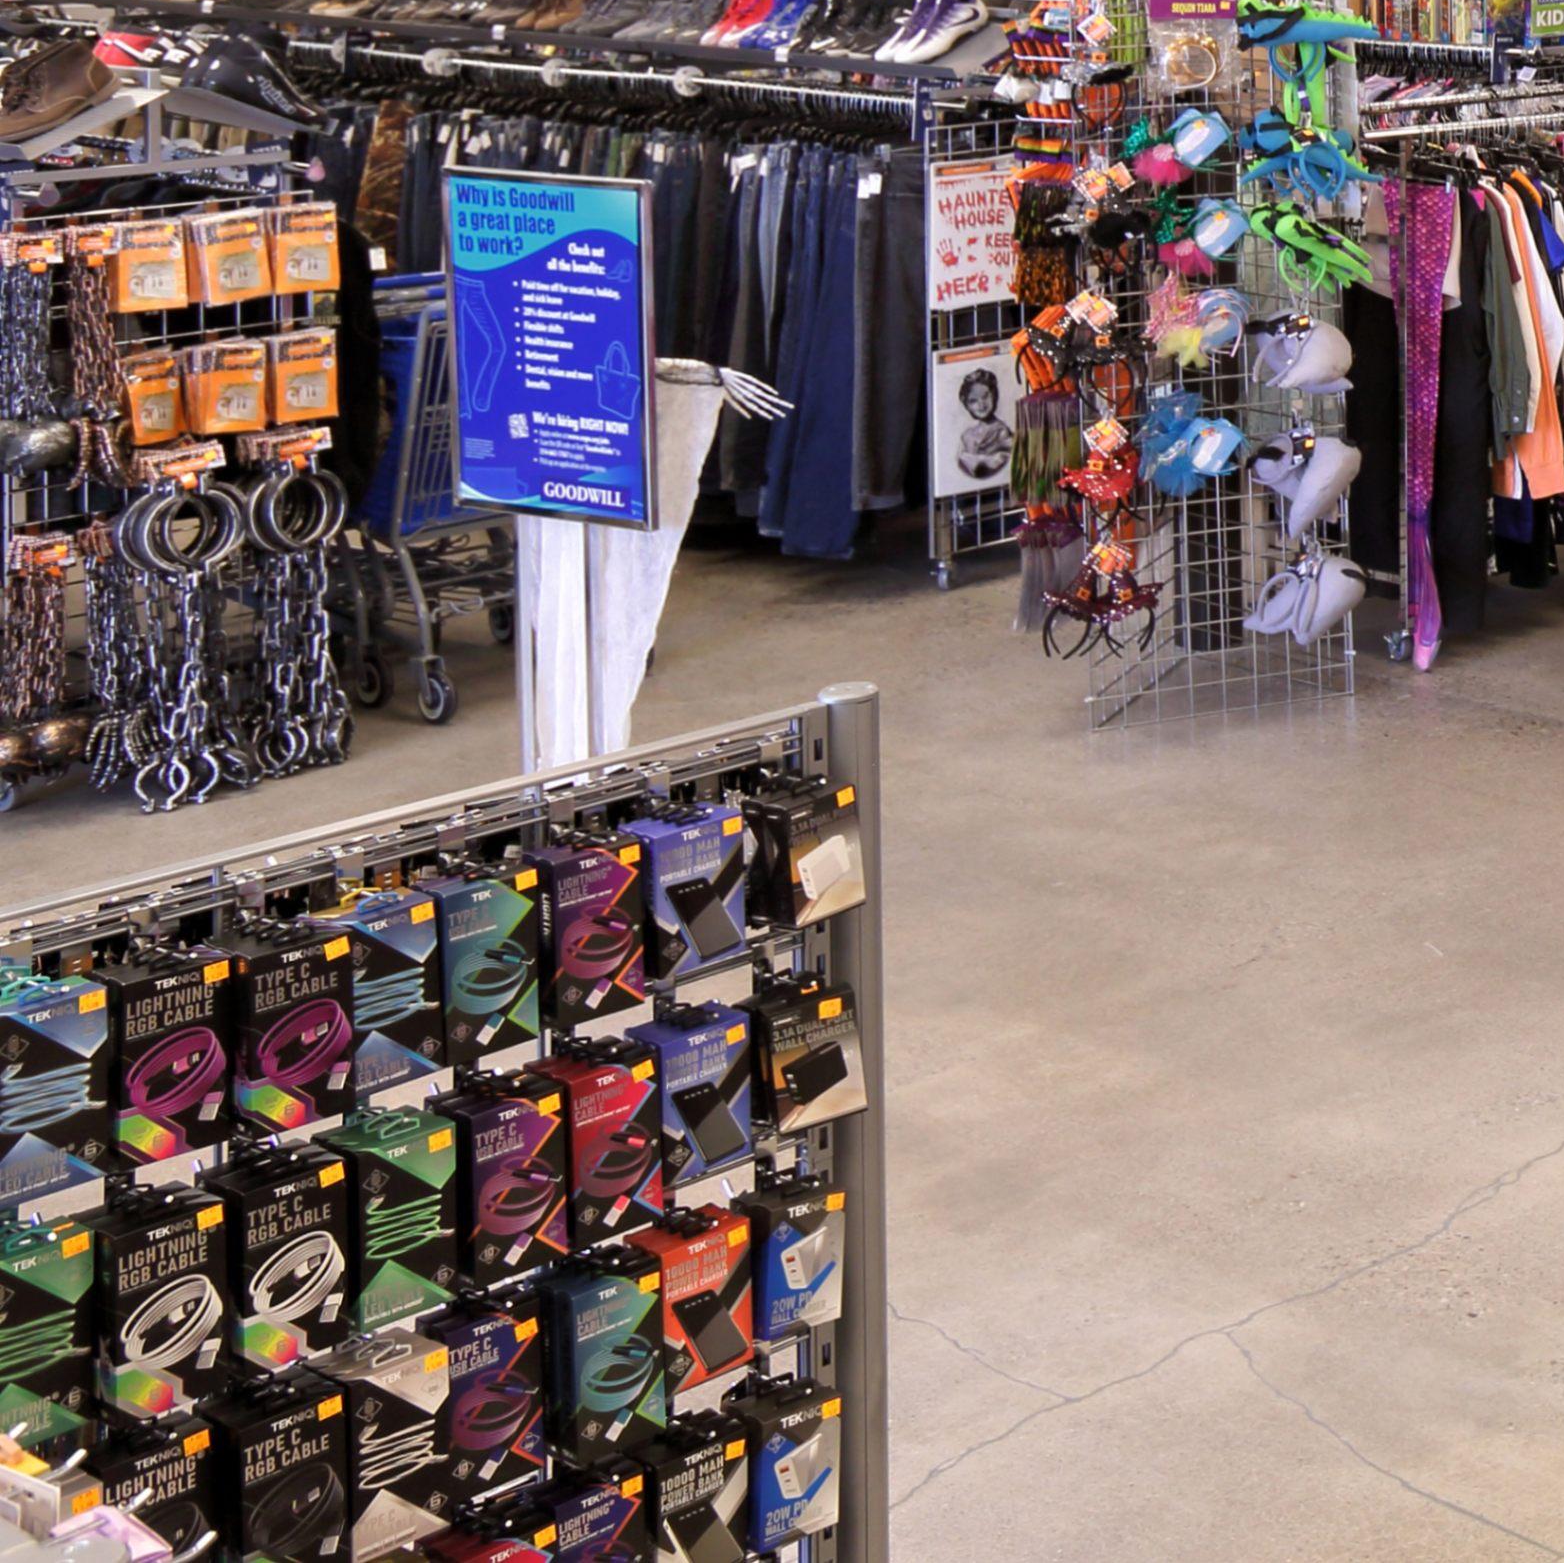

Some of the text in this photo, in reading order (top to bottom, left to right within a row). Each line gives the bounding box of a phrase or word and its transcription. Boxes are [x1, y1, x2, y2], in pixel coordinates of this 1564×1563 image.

[1171, 2, 1217, 15] SEQUIN TIARA
[456, 184, 575, 213] Why is Goodwill
[938, 189, 1013, 214] HAUNTE
[458, 211, 555, 235] a great place
[954, 209, 1005, 230] HOUSE
[459, 233, 524, 256] to work?
[568, 242, 605, 258] Check out
[547, 258, 605, 276] all the benefits:
[521, 279, 535, 290] Paid
[536, 281, 550, 291] time
[559, 283, 568, 293] for
[523, 294, 534, 302] and
[535, 294, 544, 303] sick
[937, 274, 989, 302] HELP
[524, 321, 546, 332] Flexible
[537, 308, 561, 320] discount
[570, 311, 596, 323] Goodwill
[524, 336, 573, 349] Health insurance
[525, 350, 559, 362] Retirement
[526, 379, 551, 390] benefits
[548, 367, 564, 377] vision
[565, 368, 578, 379] and
[579, 372, 593, 381] more
[532, 410, 629, 436] We're hiring RIGHT NOW!
[543, 481, 625, 507] GOODWILL
[281, 944, 324, 964] TEKNIQ
[154, 973, 201, 991] TEKNIQ
[255, 962, 310, 991] TYPE C
[255, 971, 339, 1010] RGB CABLE
[126, 986, 214, 1021] LIGHTNING
[126, 999, 214, 1036] RGB CABLE
[797, 1018, 823, 1035] DUAL
[772, 1021, 855, 1053] WALL CHARGER
[475, 1122, 517, 1148] TYPE C
[497, 1133, 524, 1154] CABLE
[247, 1196, 303, 1227] TYPE C
[247, 1203, 332, 1245] RGB CABLE
[118, 1230, 208, 1274] LIGHTNING
[118, 1246, 209, 1291] RGB CABLE
[772, 1298, 796, 1314] 20W
[450, 1336, 492, 1364] TYPE C
[470, 1347, 499, 1370] CABLE
[270, 1407, 316, 1433] TEKNIQ
[134, 1444, 182, 1470] TEKNIQ
[244, 1428, 301, 1465] TYPE C
[244, 1433, 330, 1484] RGB CABLE
[684, 1444, 723, 1466] TEKNIQ
[105, 1456, 197, 1505] LIGHTNING
[660, 1454, 724, 1493] 10000 MAH
[660, 1470, 724, 1504] POWER BANK
[661, 1480, 724, 1512] PORTABLE CHARGER
[558, 1500, 611, 1536] LIGHTNING
[766, 1507, 791, 1525] 20W
[559, 1524, 591, 1547] CABLE
